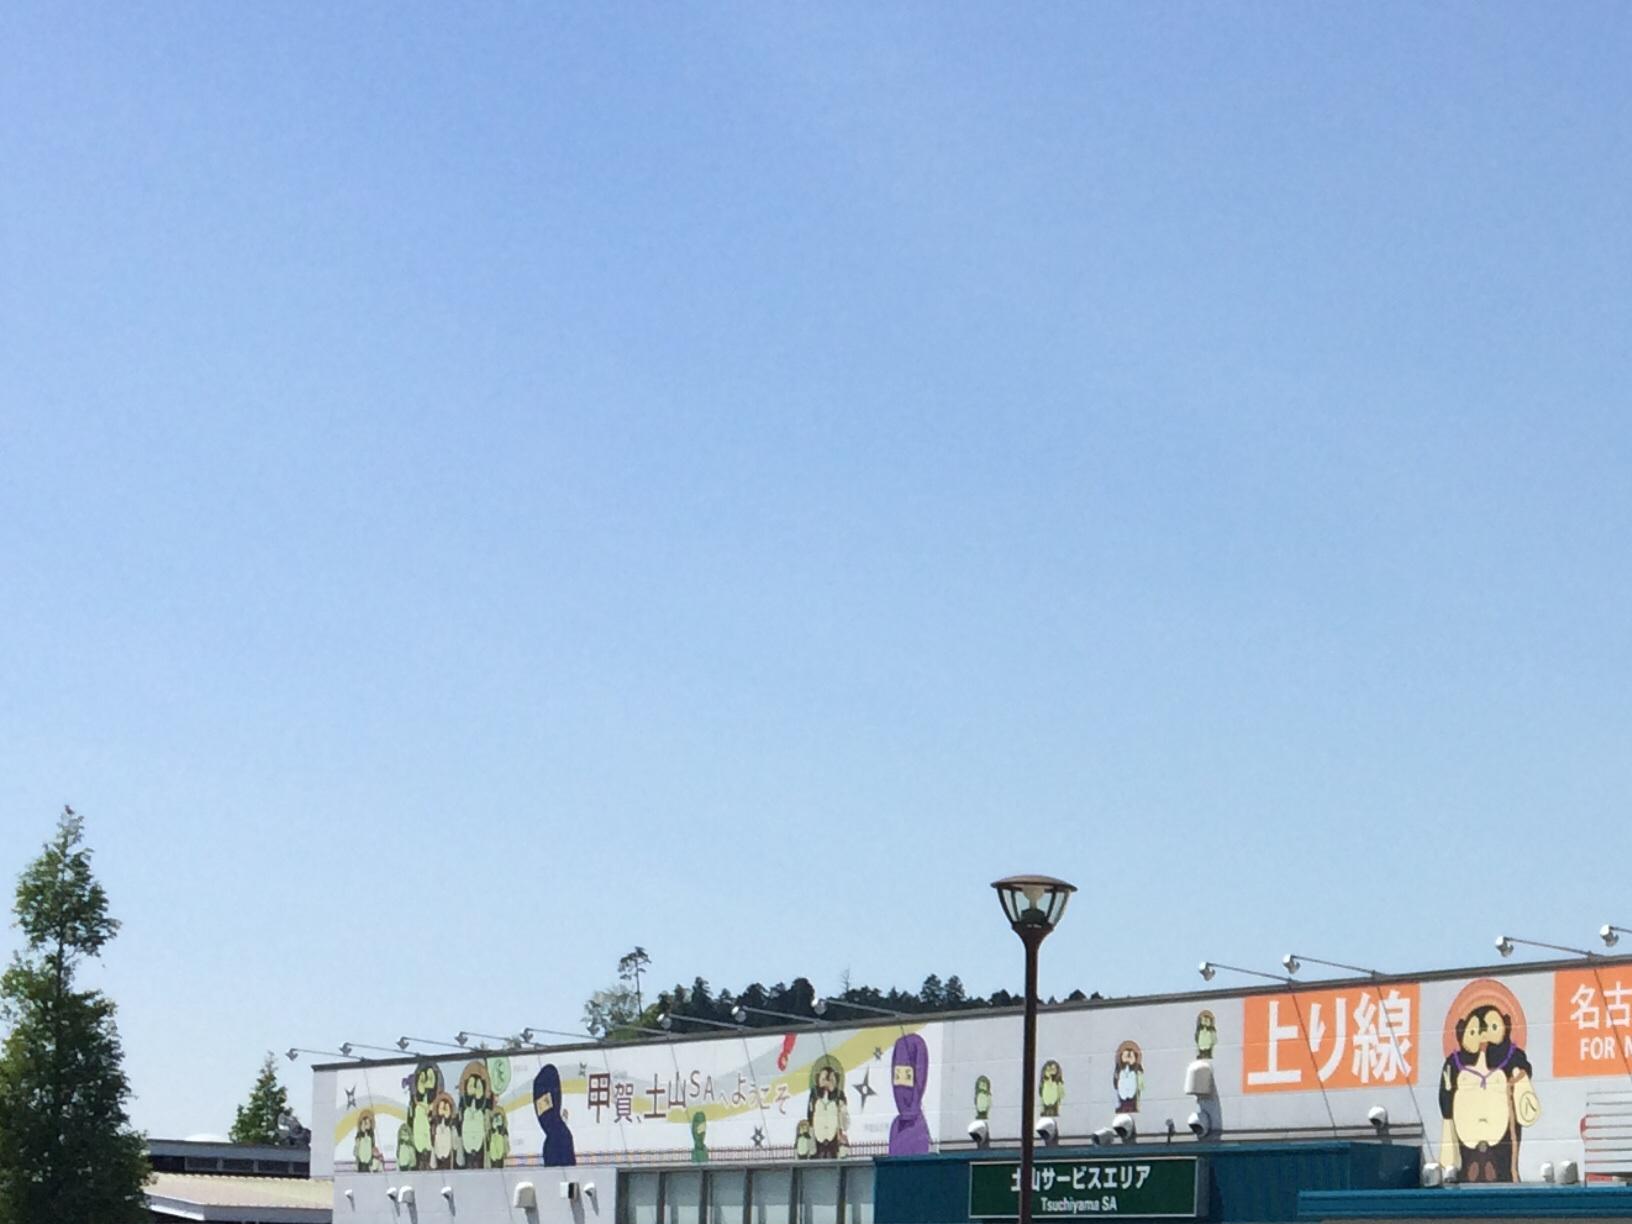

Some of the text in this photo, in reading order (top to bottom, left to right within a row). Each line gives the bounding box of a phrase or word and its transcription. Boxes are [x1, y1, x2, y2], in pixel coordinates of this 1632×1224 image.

[1247, 989, 1412, 1085] 上り線
[1579, 1036, 1616, 1061] FOR
[1040, 1196, 1119, 1215] Tsuchiyama SA
